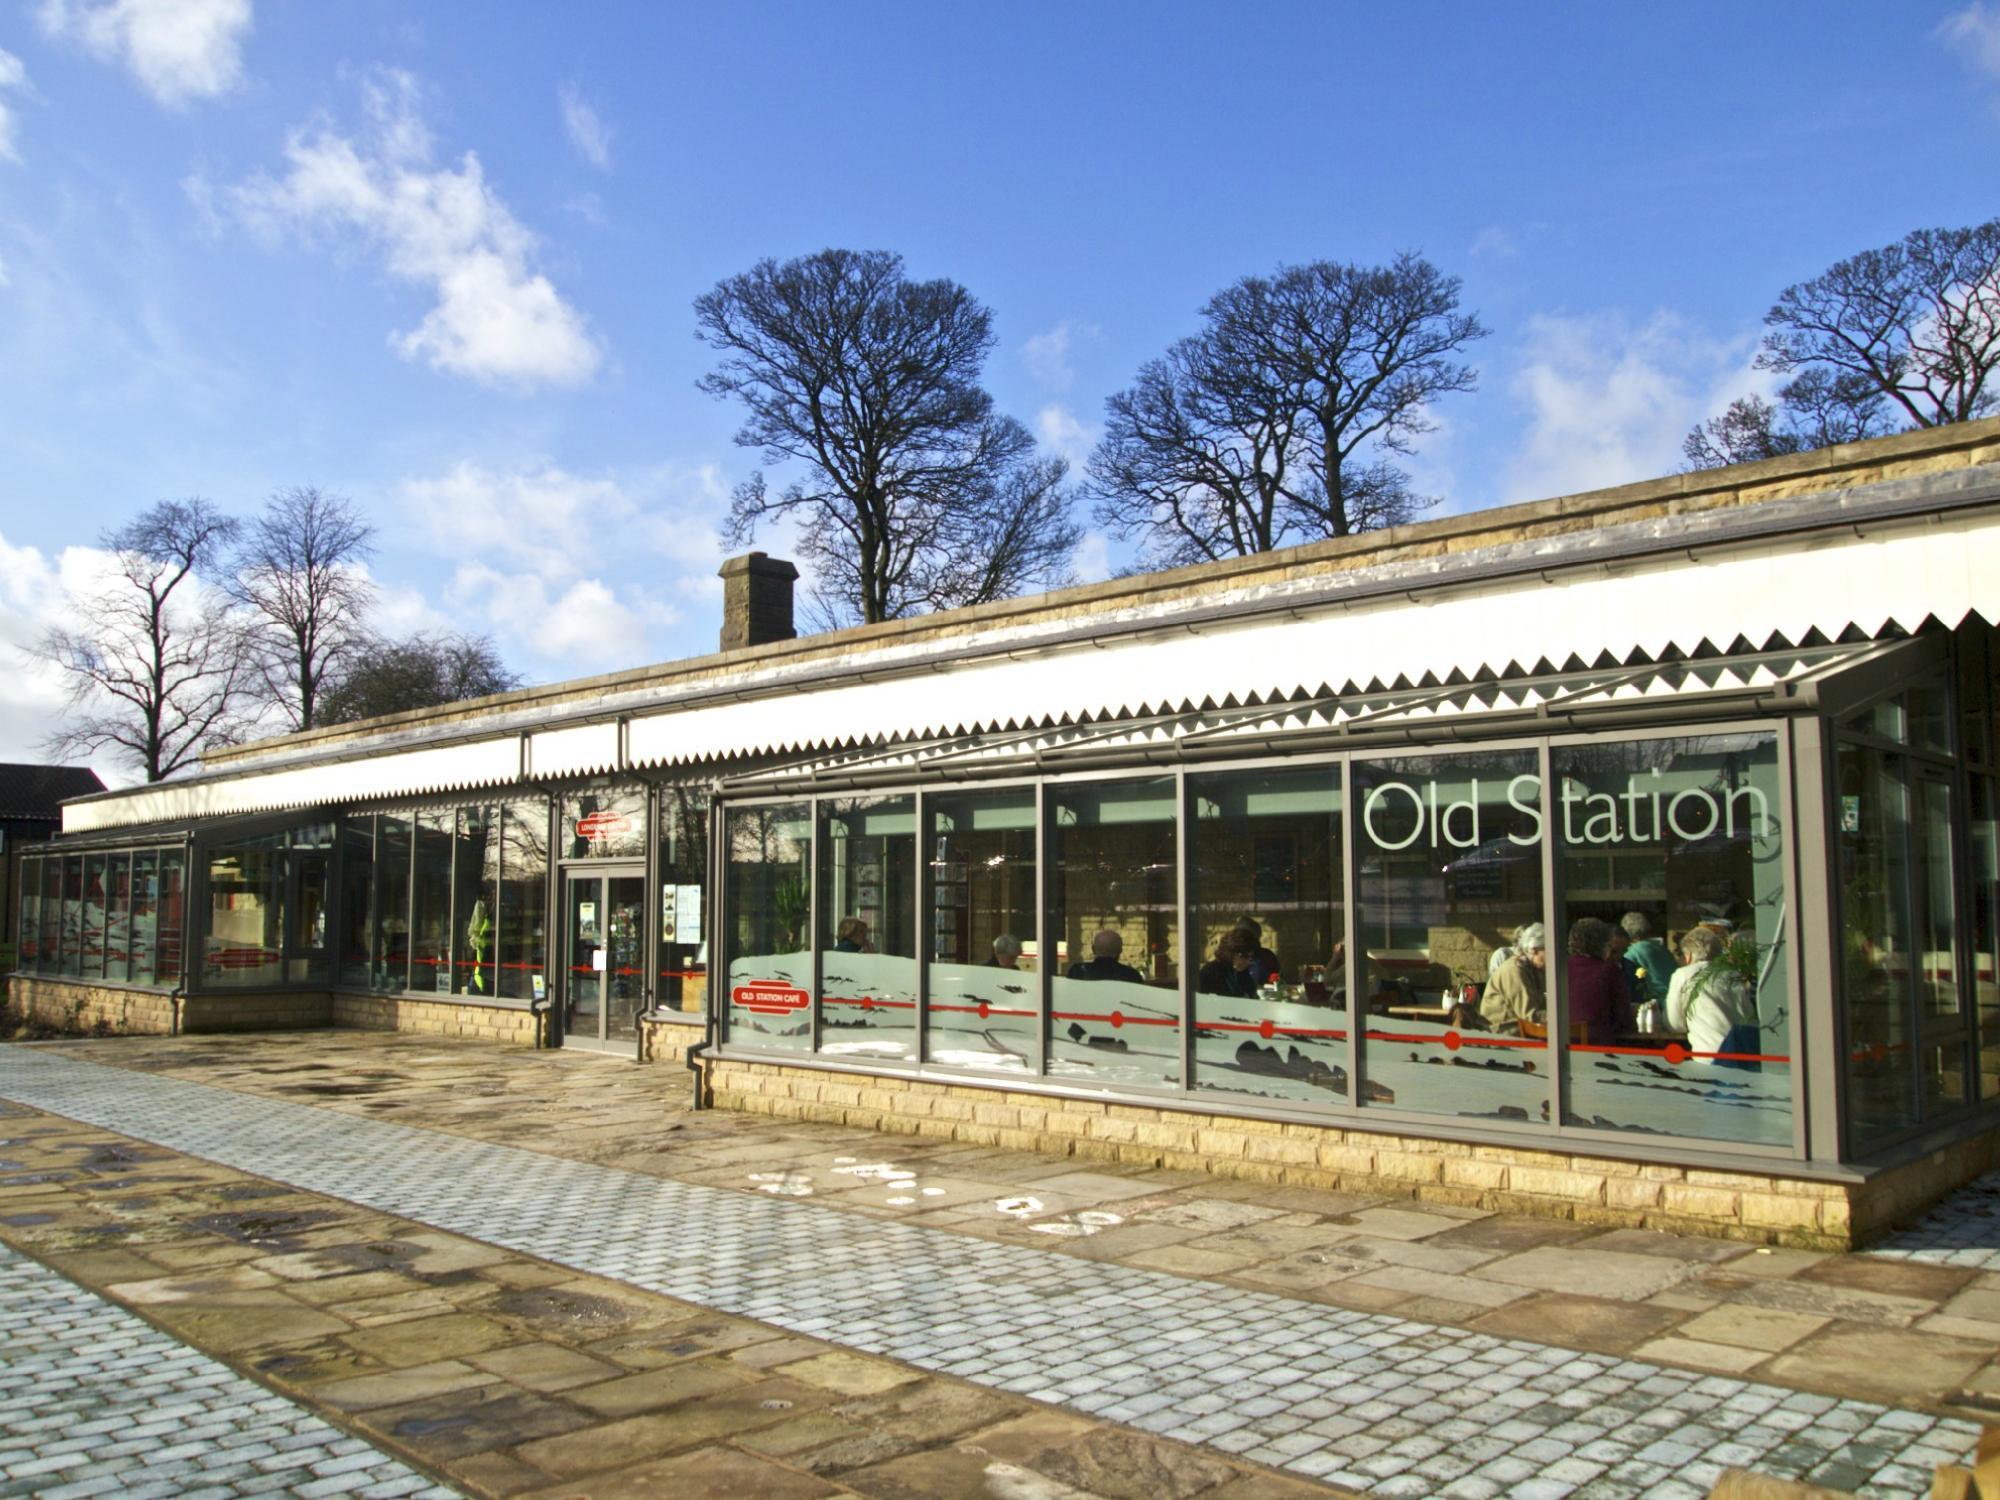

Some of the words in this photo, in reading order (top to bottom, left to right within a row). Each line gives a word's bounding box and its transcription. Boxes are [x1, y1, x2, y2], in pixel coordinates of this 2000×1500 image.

[1363, 778, 1480, 850] Old
[1507, 767, 1769, 846] Station
[741, 992, 754, 1000] OLD
[756, 993, 783, 1002] STATION
